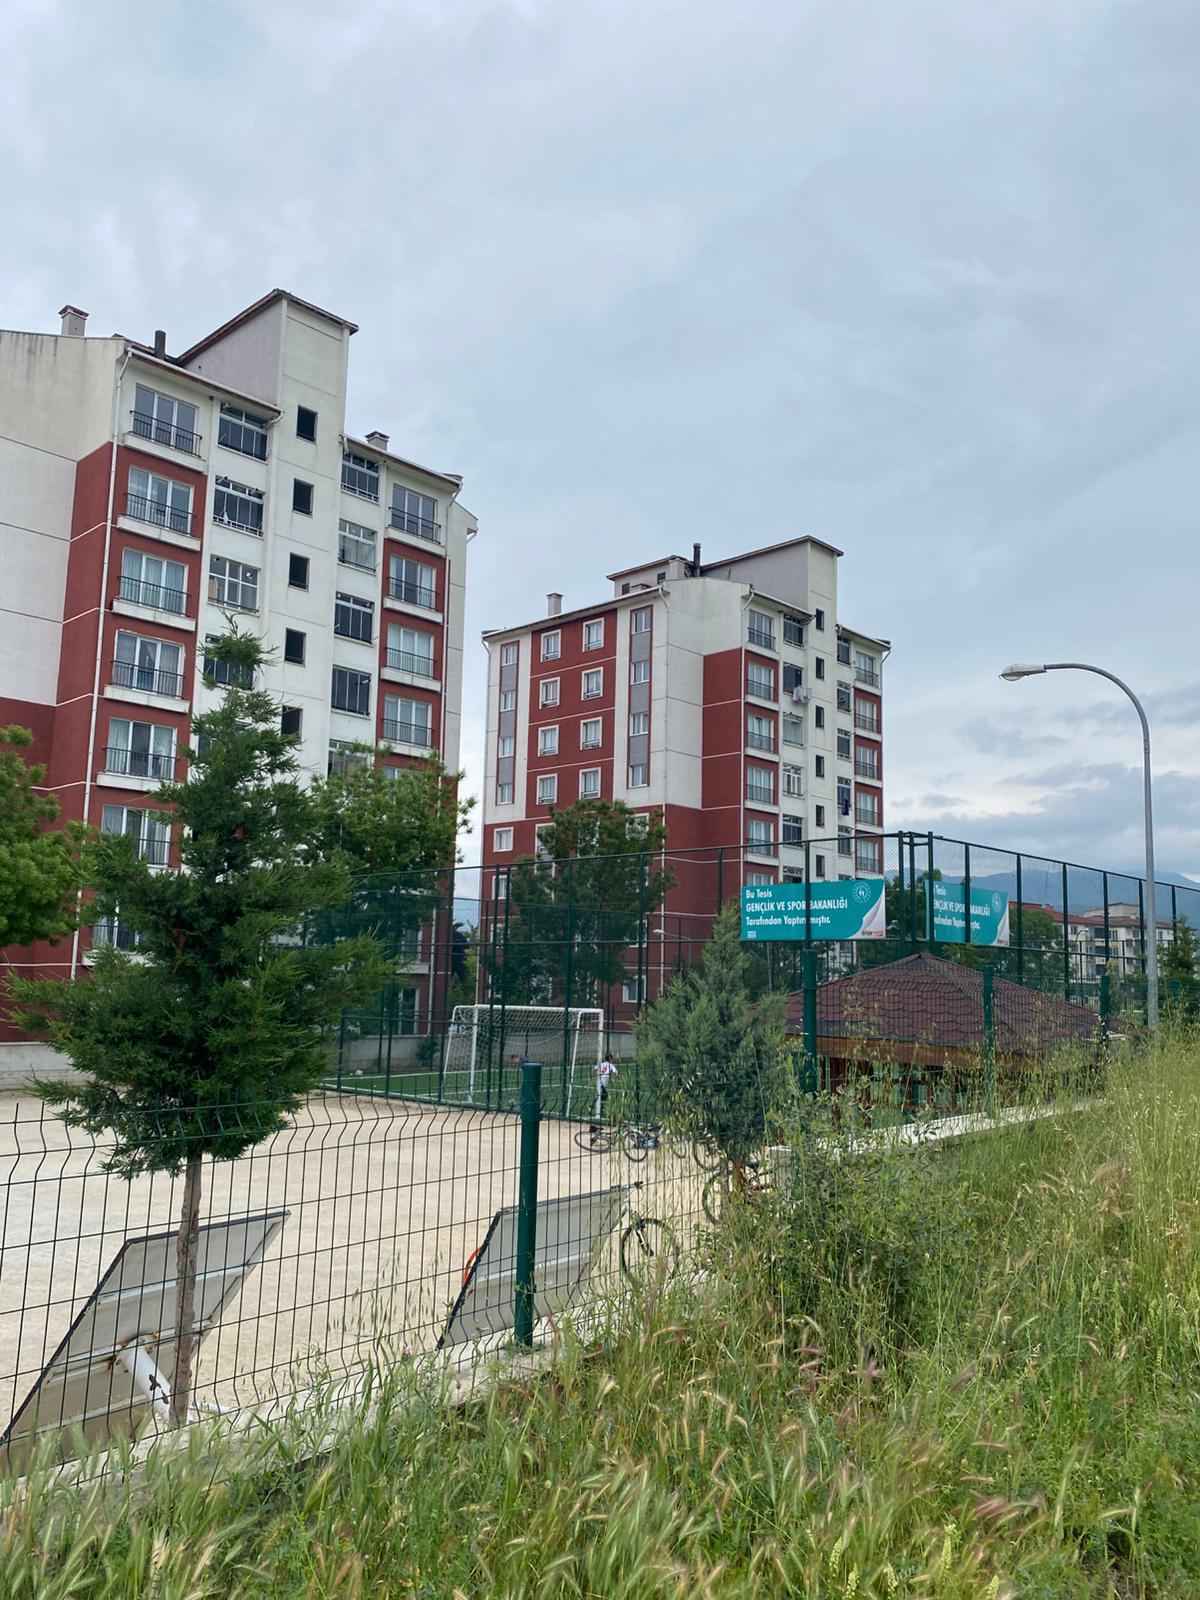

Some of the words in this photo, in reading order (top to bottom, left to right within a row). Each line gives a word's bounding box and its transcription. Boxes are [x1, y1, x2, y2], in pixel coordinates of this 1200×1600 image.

[746, 889, 754, 898] Bu
[756, 888, 772, 898] Tesis
[746, 900, 775, 914] GENÇLİK
[776, 901, 785, 911] VE
[787, 900, 806, 911] SPOR
[746, 915, 782, 926] Tarafından
